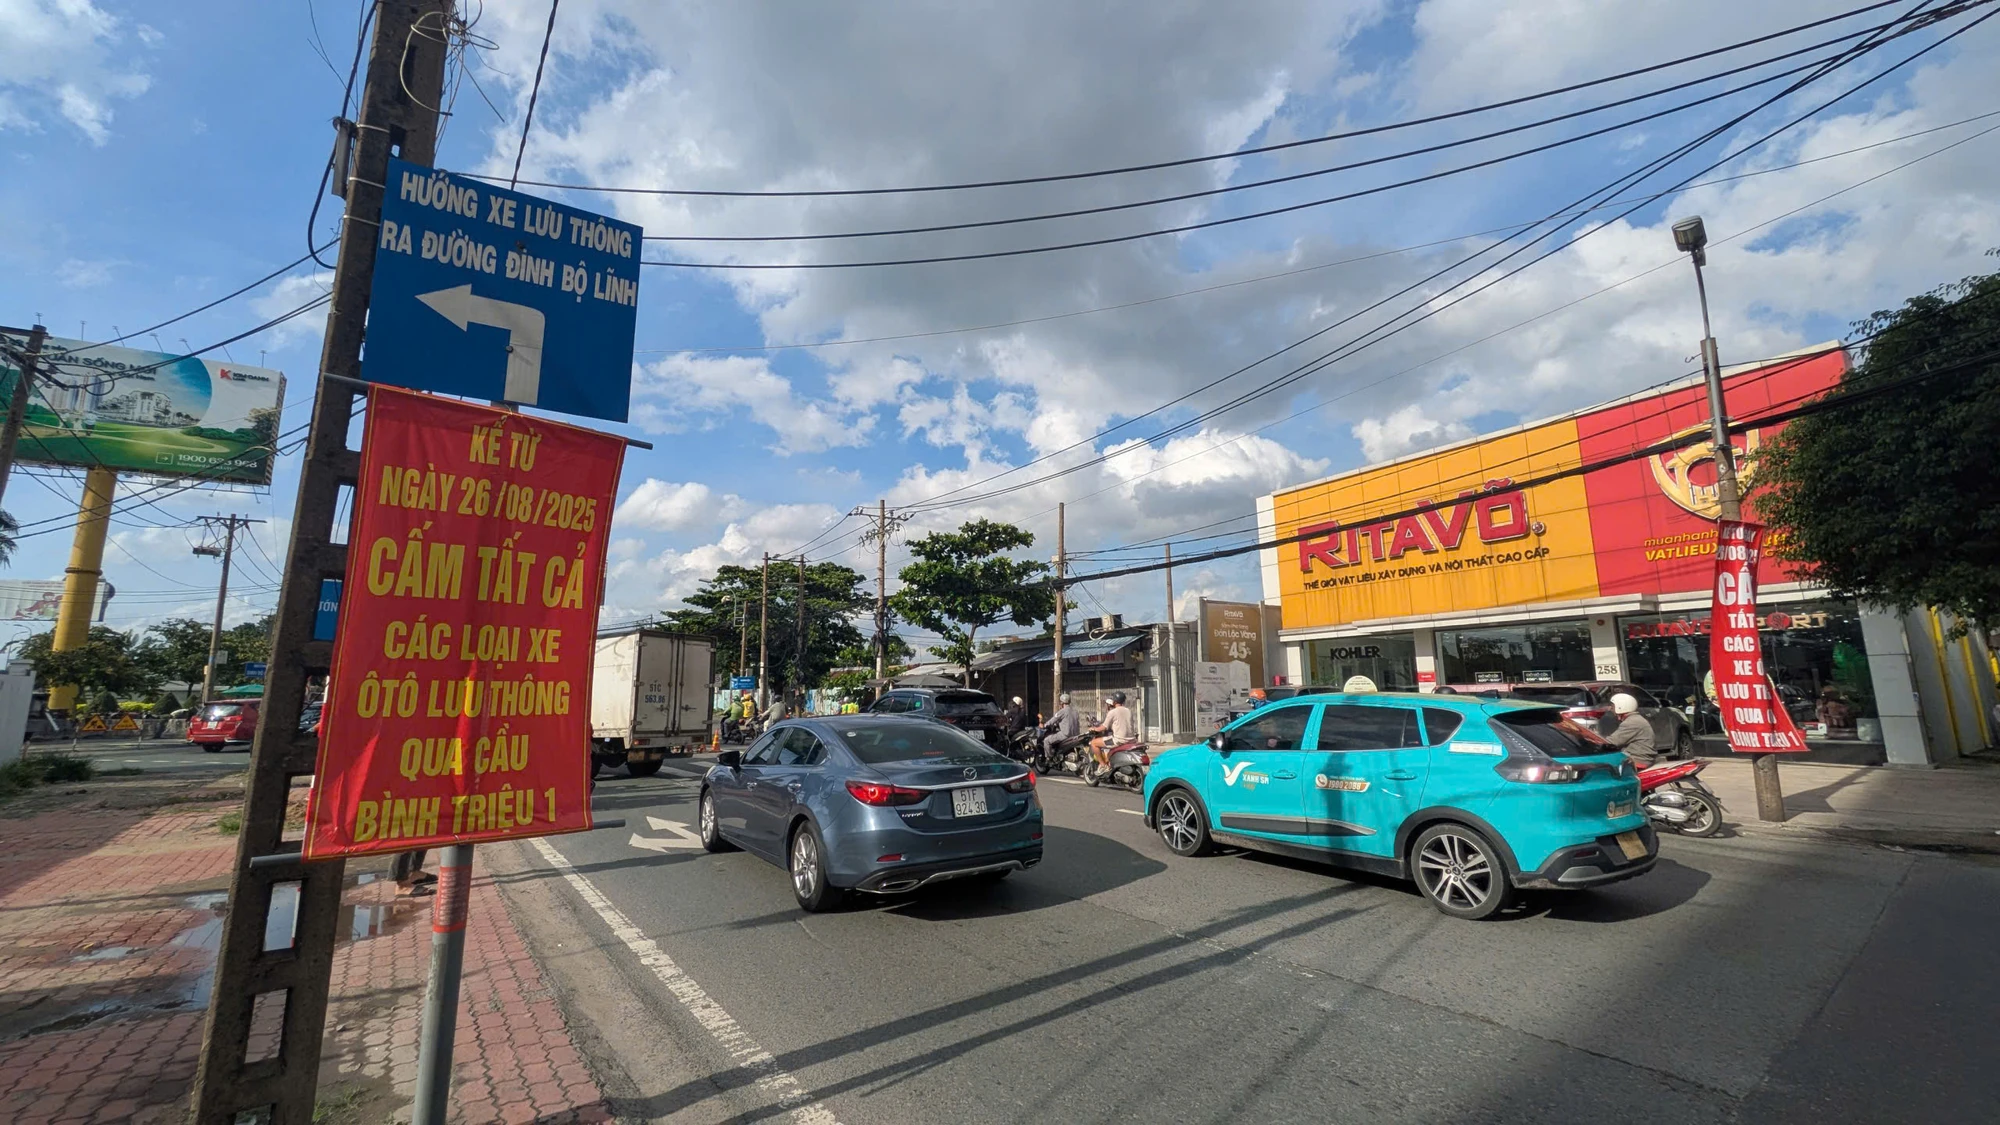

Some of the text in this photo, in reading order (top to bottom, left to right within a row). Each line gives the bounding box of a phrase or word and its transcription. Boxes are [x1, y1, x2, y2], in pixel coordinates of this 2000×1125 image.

[400, 170, 632, 258] HƯỚNG XE LƯU THÔNG
[380, 220, 412, 255] RA
[421, 228, 497, 274] ĐƯỜNG
[562, 260, 588, 303] BỘ
[593, 267, 637, 307] LĨNH
[178, 454, 206, 464] 1900
[469, 415, 543, 472] KỂ TỪ
[379, 462, 456, 512] NGÀY
[367, 521, 587, 610] CẤM TẤT CẢ
[1304, 579, 1320, 591] THẾ
[1321, 577, 1337, 589] GIỚI
[1378, 570, 1397, 581] XÂY
[1399, 565, 1426, 578] DỰNG
[1428, 561, 1443, 574] VÀ
[1466, 554, 1494, 569] THẤT
[1496, 552, 1522, 564] CAO
[1524, 546, 1550, 560] CẤP
[384, 614, 562, 670] CÁC LOẠI XE
[1330, 645, 1381, 660] KOHLER
[1724, 634, 1755, 653] CÁC
[1597, 664, 1618, 676] 258
[1733, 659, 1753, 676] XE
[357, 670, 571, 719] ÔTÔ LƯU THÔNG
[1722, 681, 1749, 700] LƯU
[1735, 707, 1764, 725] QUA
[399, 722, 530, 783] QUA CẦU
[1788, 730, 1800, 747] 1
[955, 800, 987, 816] 924.30
[960, 789, 977, 802] 51F
[354, 782, 557, 843] BÌNH TRIỆU 1
